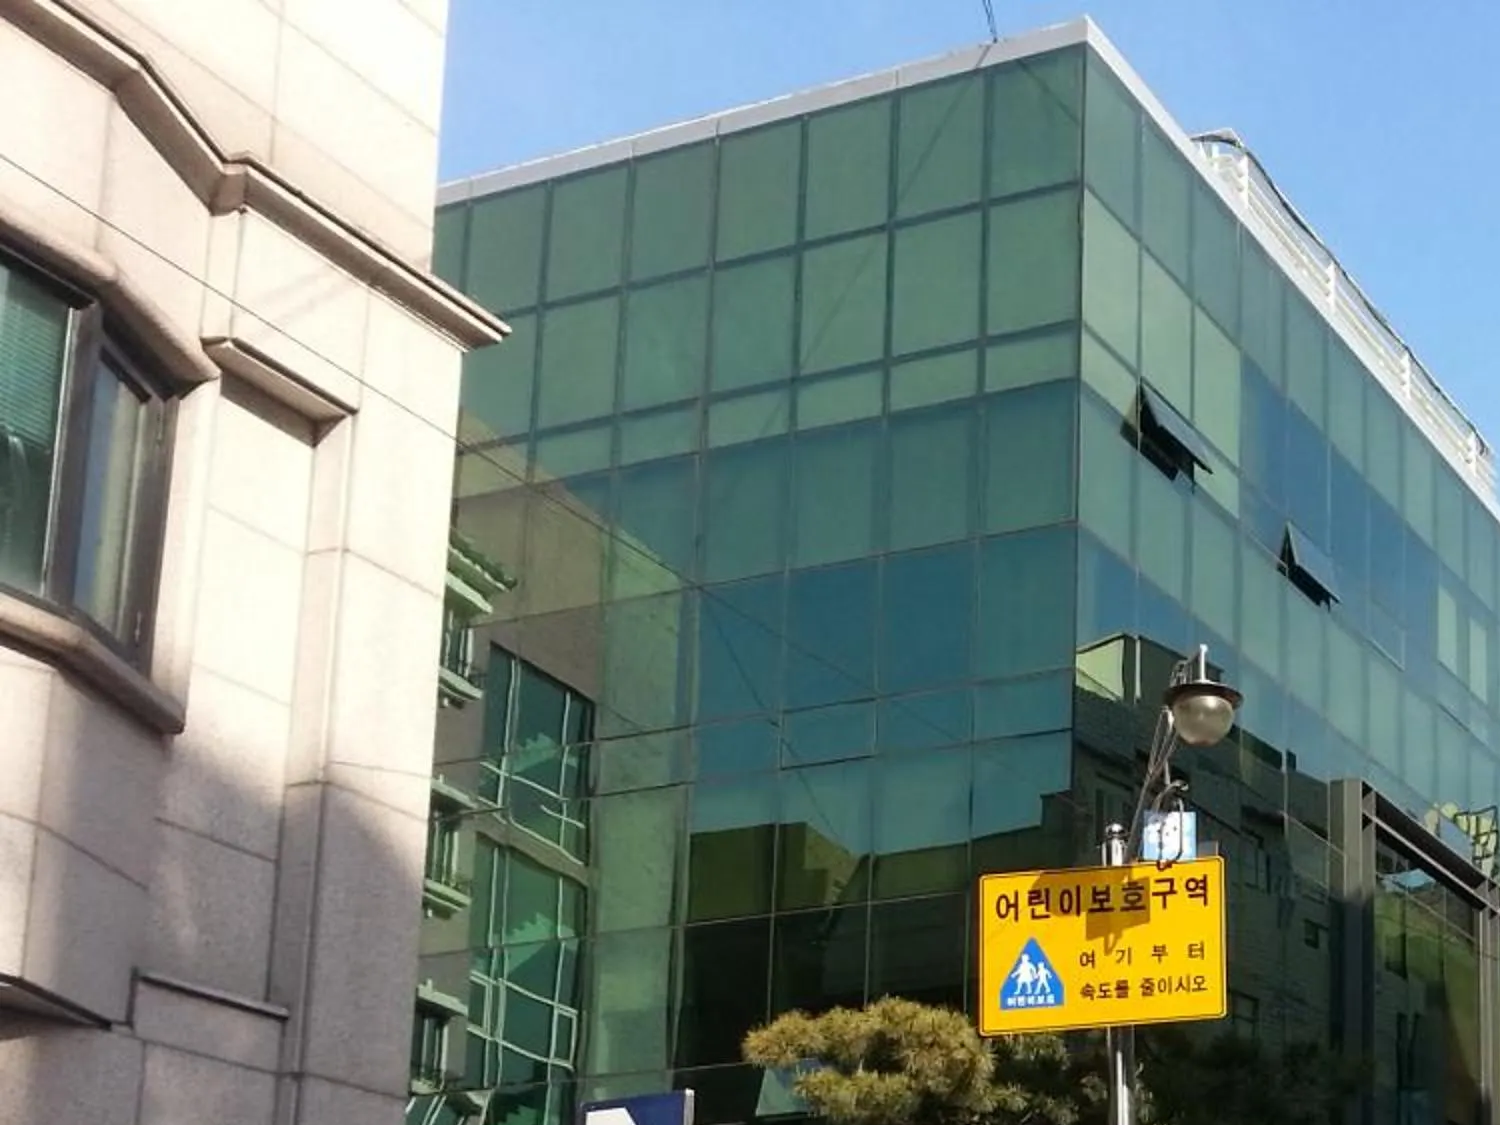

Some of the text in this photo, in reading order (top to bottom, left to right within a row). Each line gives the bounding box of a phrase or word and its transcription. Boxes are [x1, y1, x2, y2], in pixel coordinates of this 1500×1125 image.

[995, 874, 1209, 922] 어린이보호구역
[1080, 975, 1208, 1001] 속도를 줄이시오
